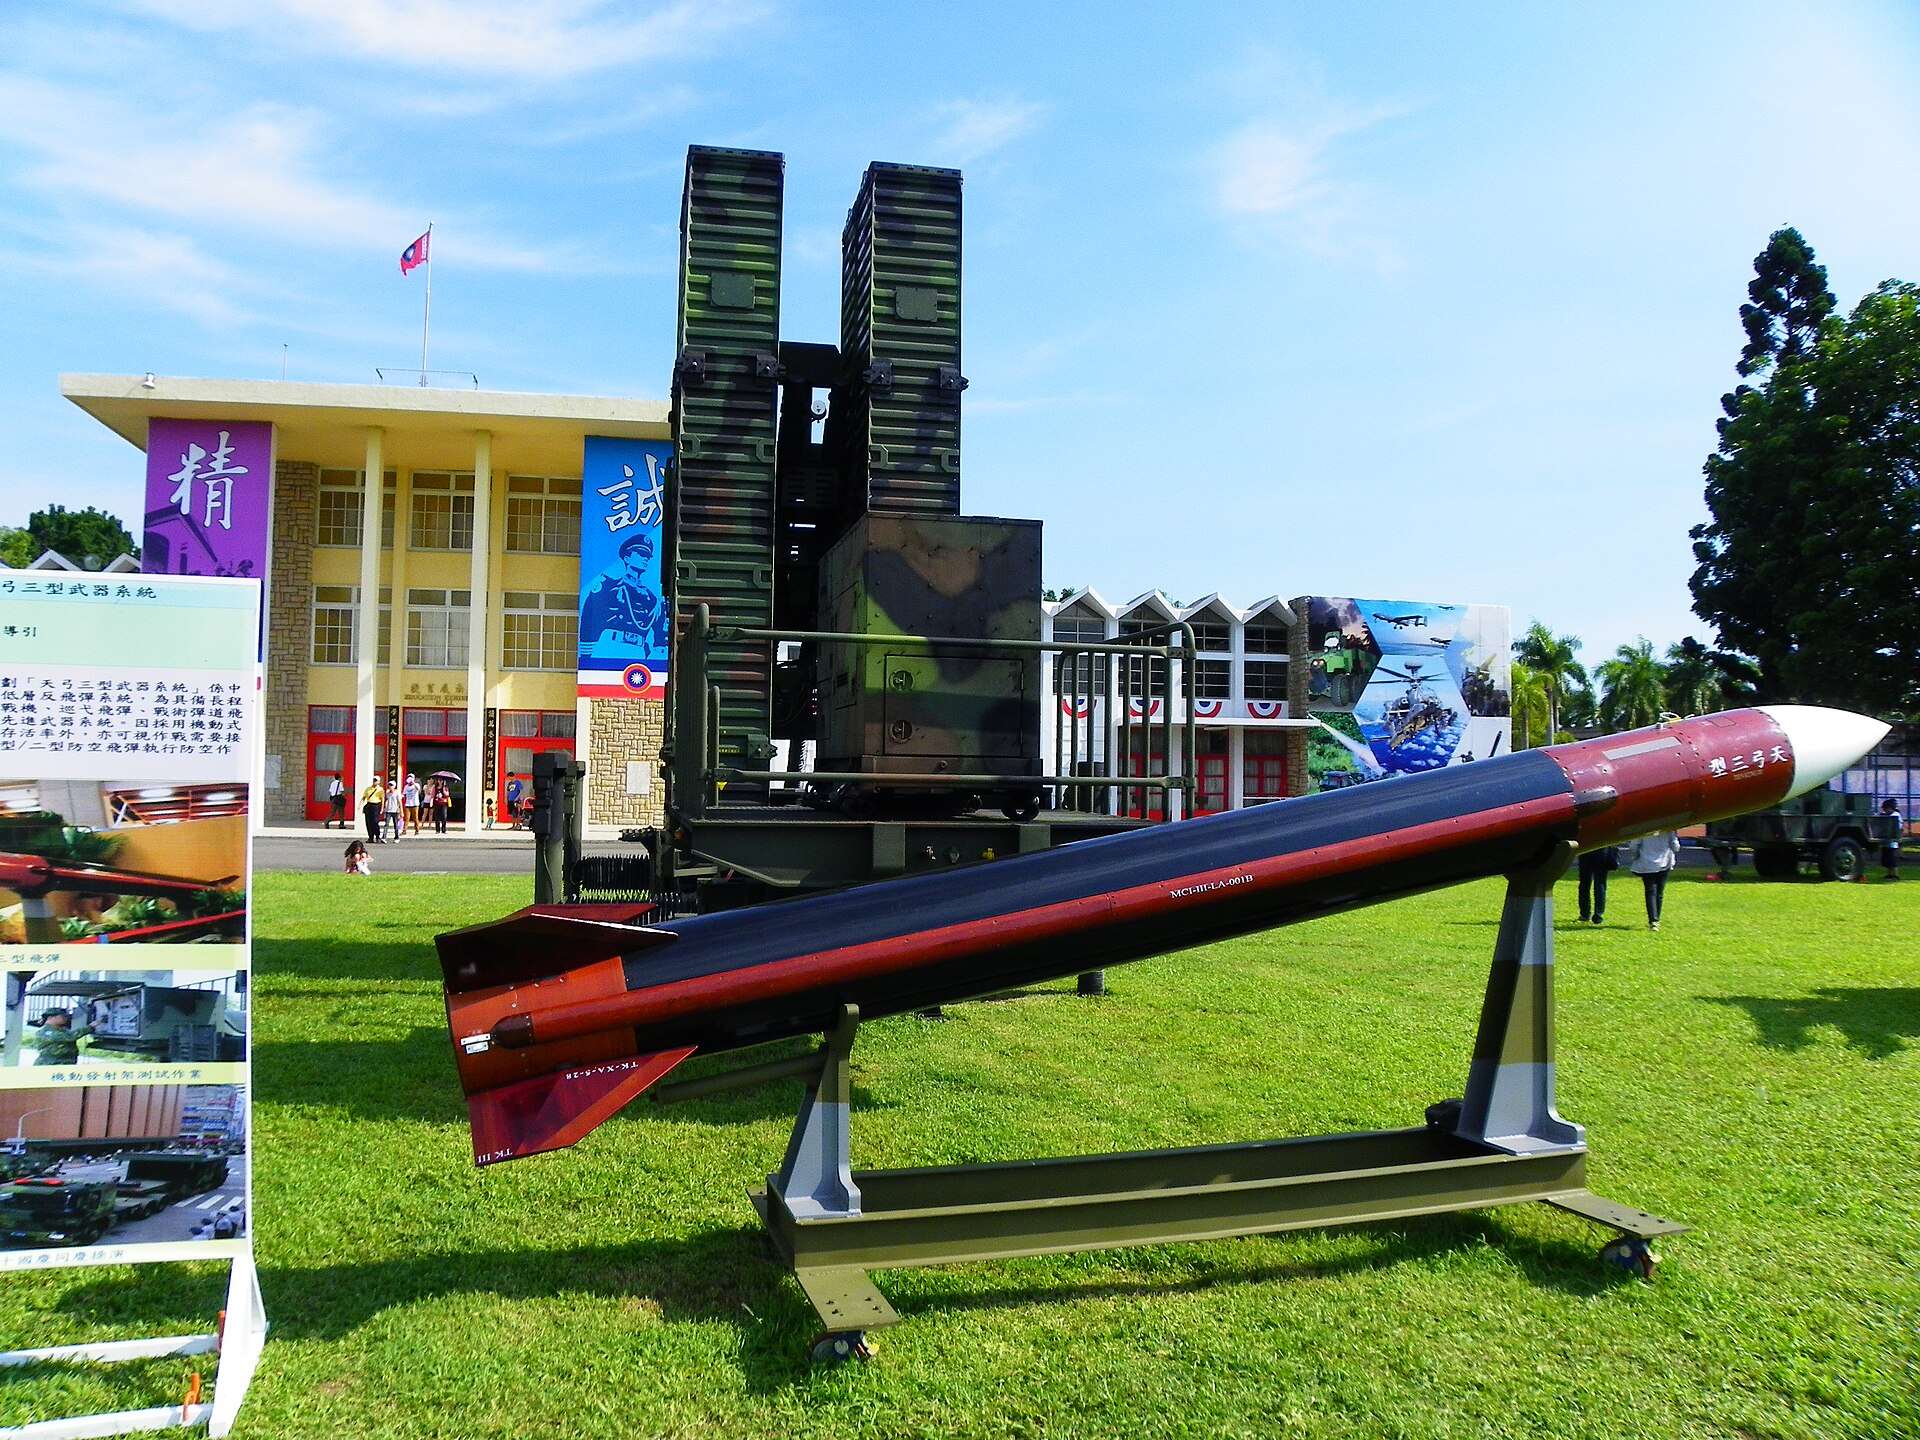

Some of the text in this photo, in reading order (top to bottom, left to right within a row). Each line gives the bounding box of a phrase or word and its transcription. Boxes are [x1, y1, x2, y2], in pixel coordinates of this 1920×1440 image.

[167, 430, 249, 530] 精
[597, 453, 665, 533] 誠
[2, 580, 157, 599] 弓三型武器系統
[4, 625, 37, 637] 導引
[1169, 874, 1254, 899] MCI-III-LA-001B
[495, 1148, 513, 1160] TK
